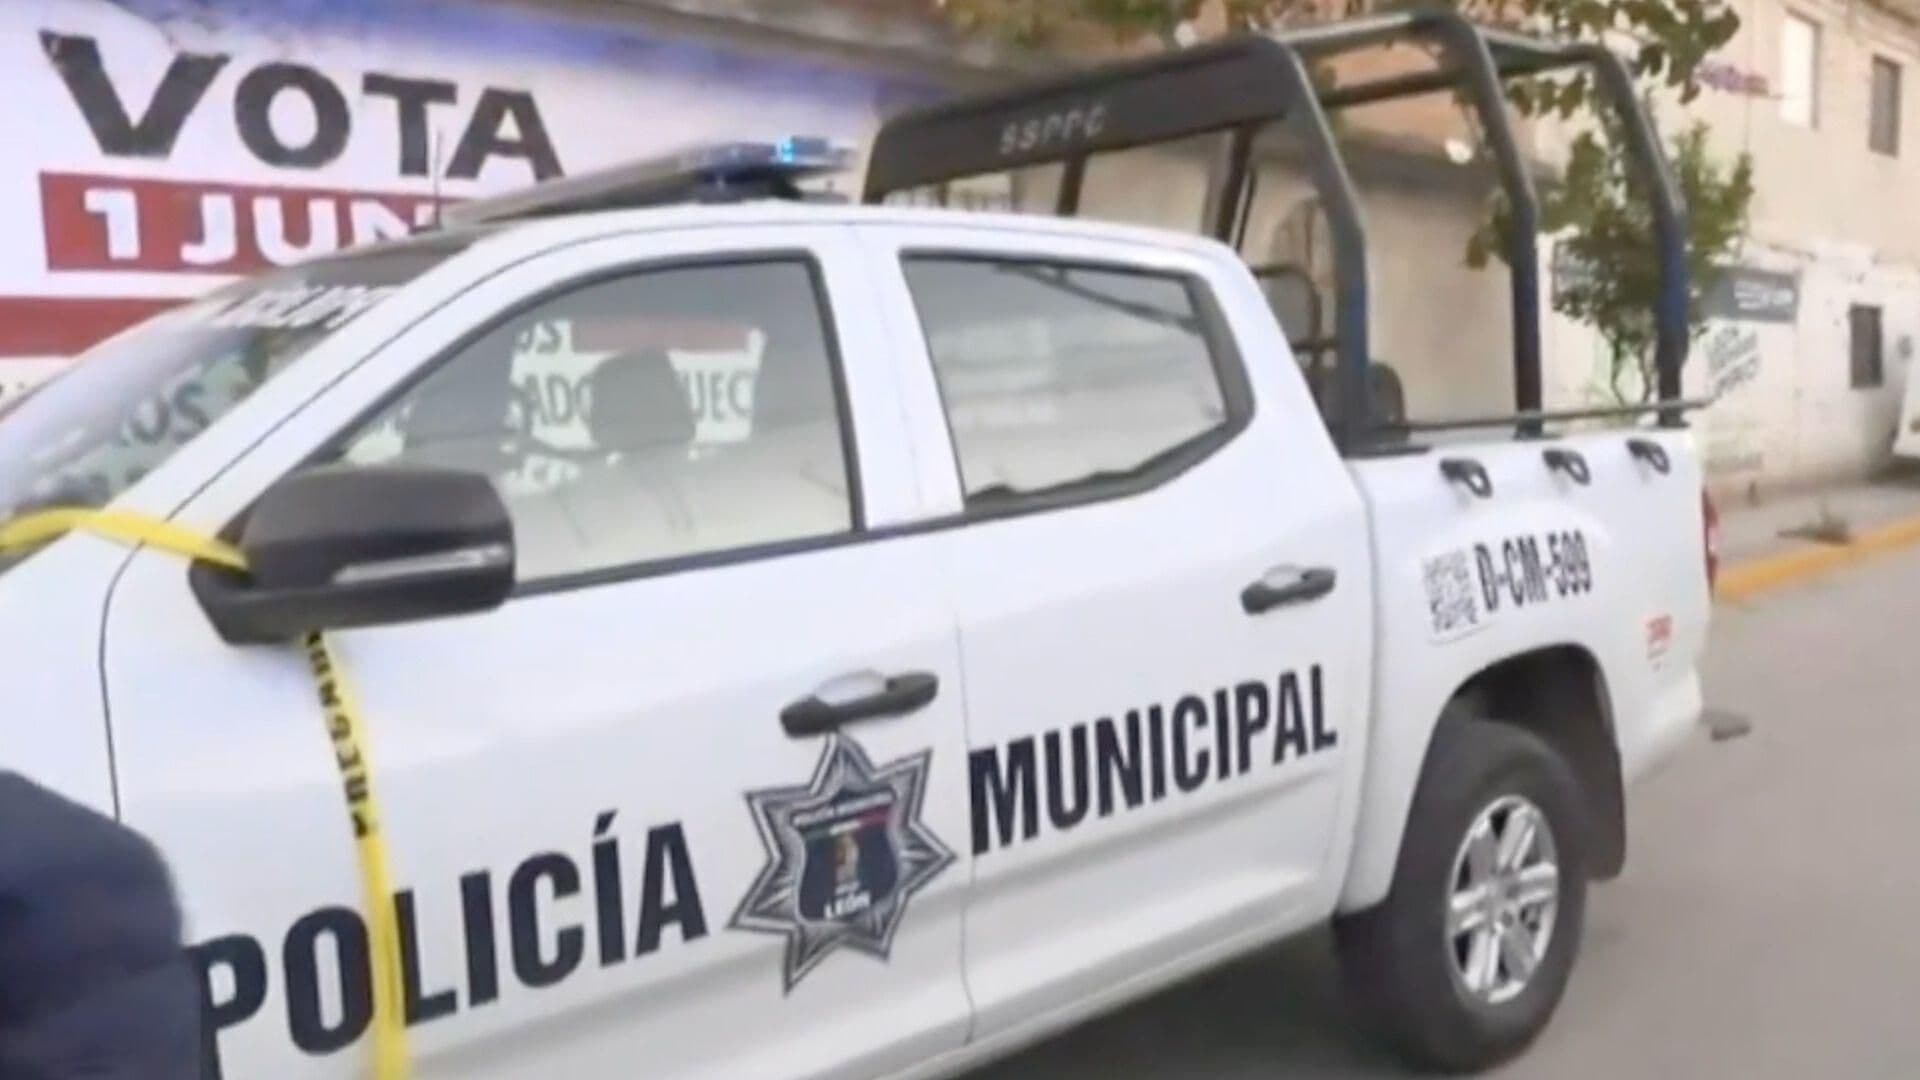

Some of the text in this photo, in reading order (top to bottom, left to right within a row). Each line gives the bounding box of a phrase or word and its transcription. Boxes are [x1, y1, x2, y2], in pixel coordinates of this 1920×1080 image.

[39, 30, 563, 182] VOTA
[85, 189, 138, 260] 1
[968, 663, 1338, 857] MUNICIPAL
[183, 810, 709, 1080] POLICÍA
